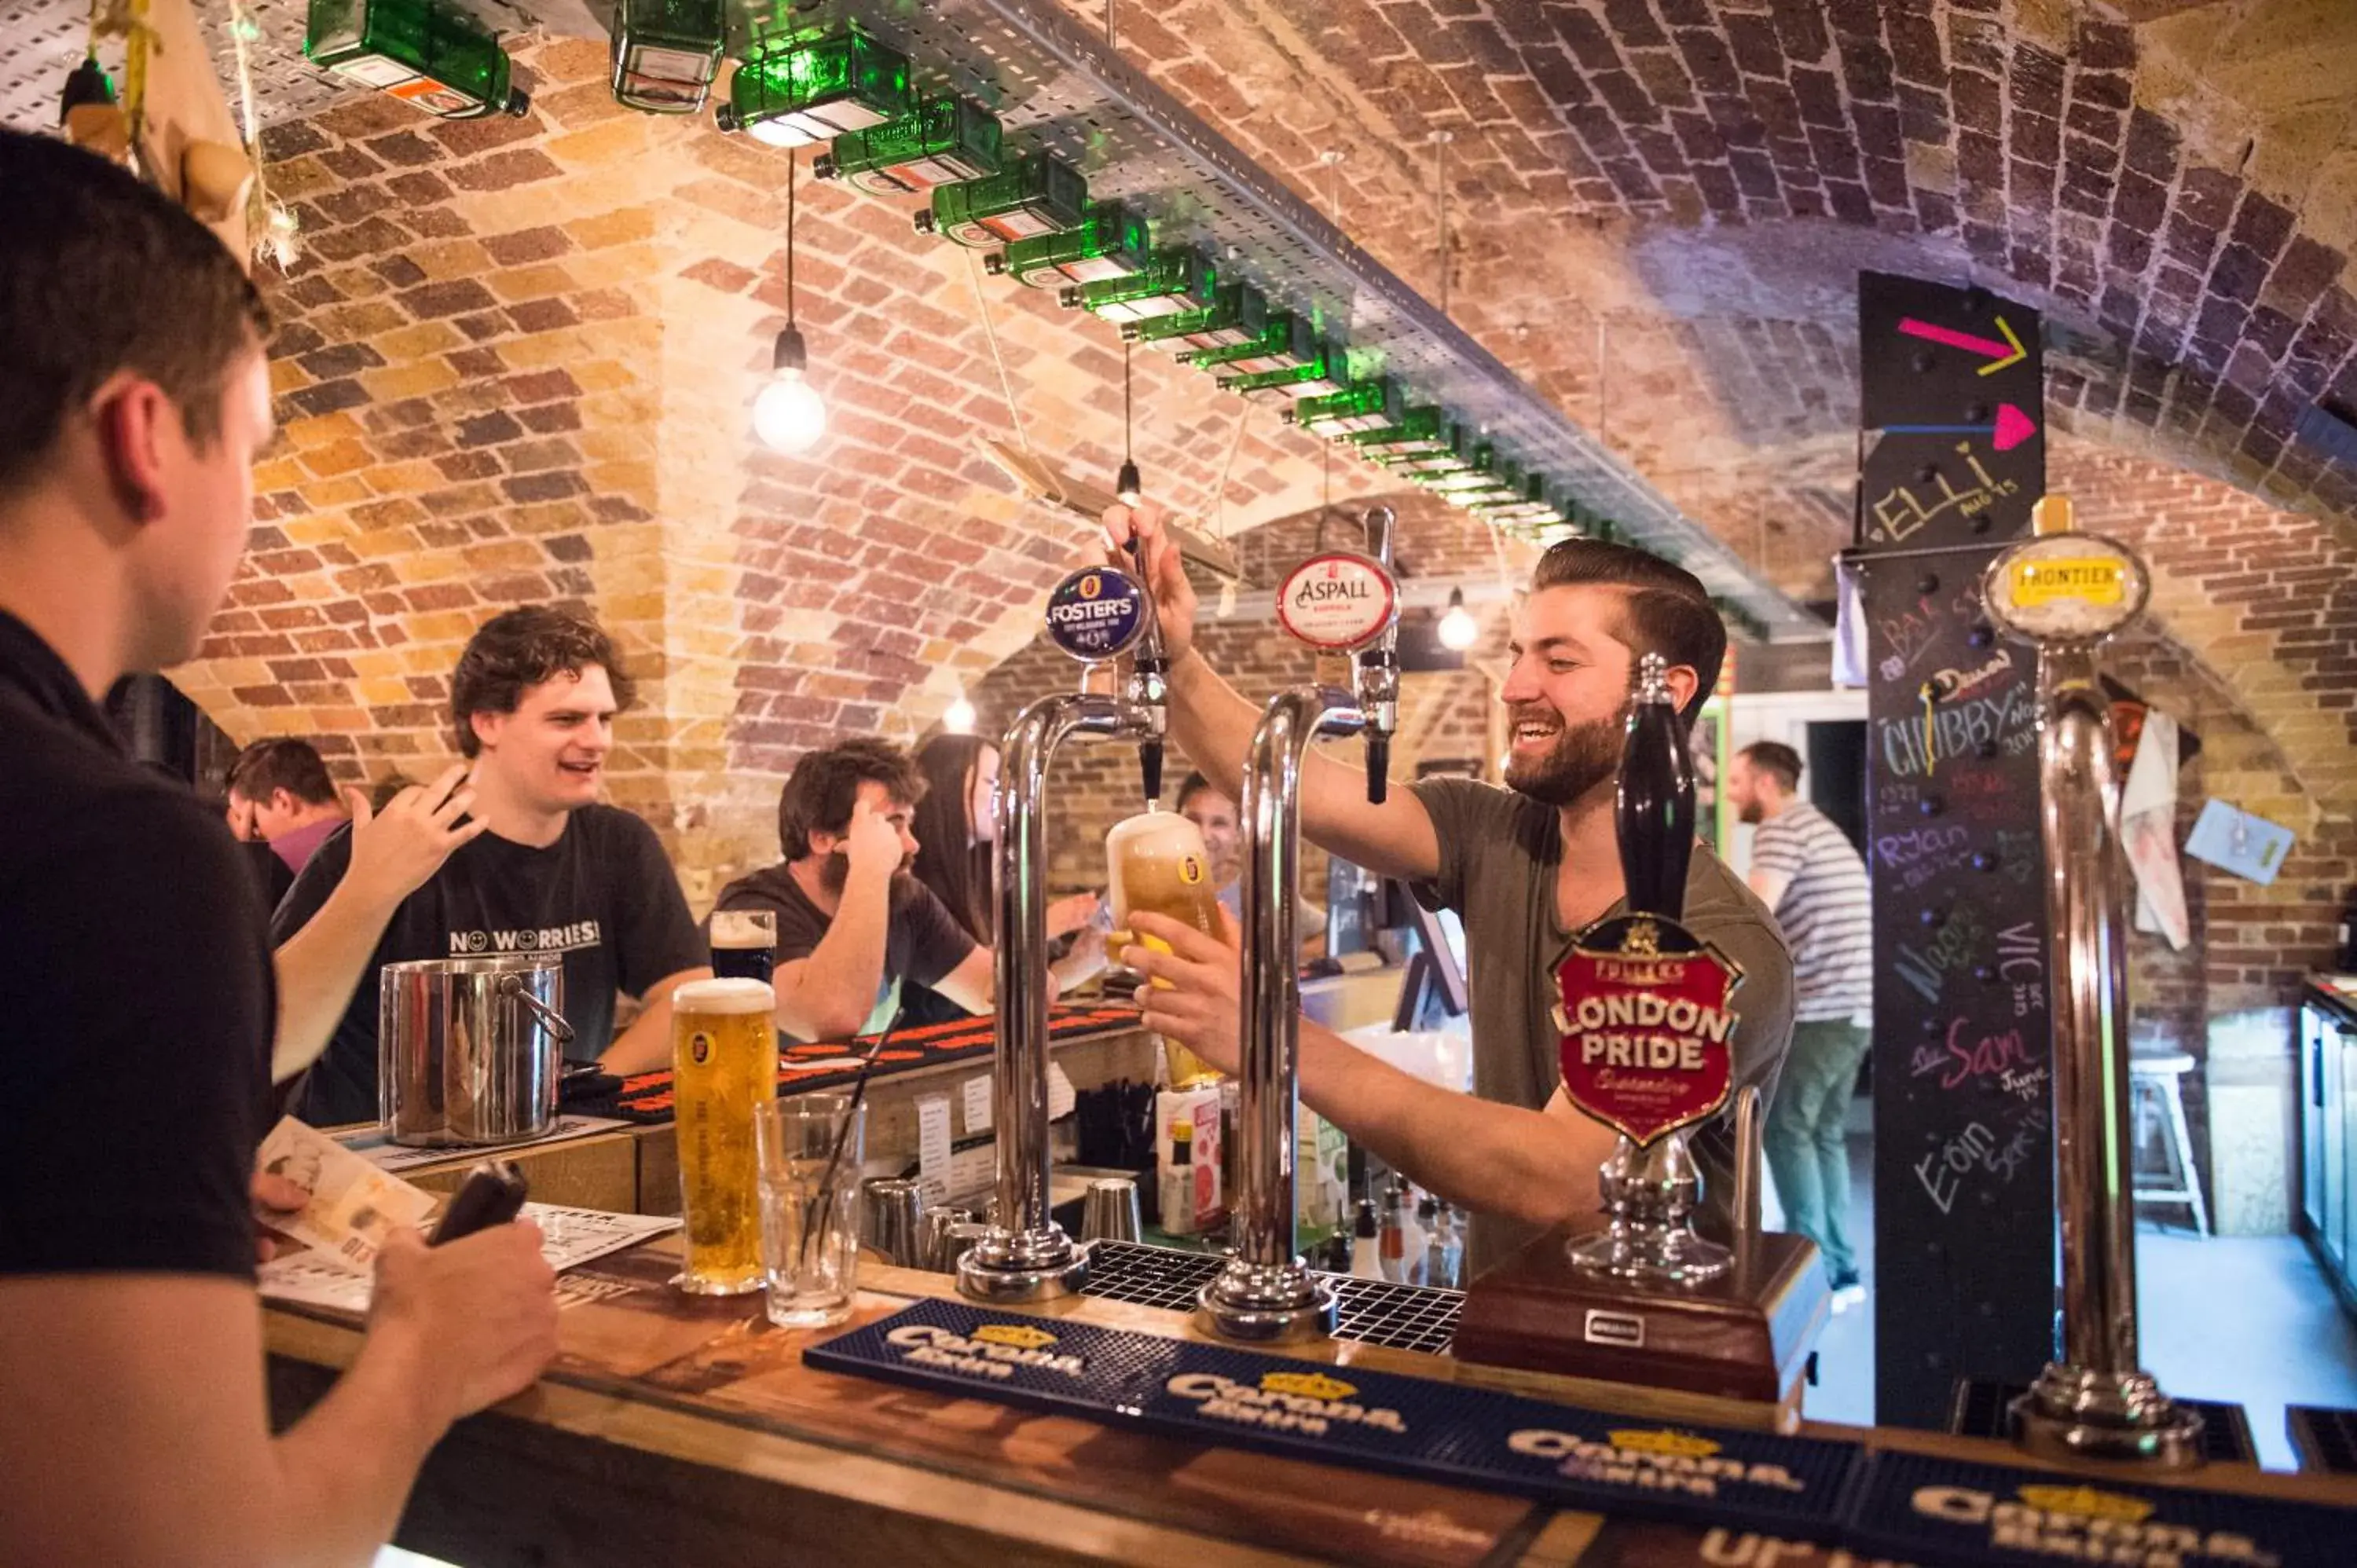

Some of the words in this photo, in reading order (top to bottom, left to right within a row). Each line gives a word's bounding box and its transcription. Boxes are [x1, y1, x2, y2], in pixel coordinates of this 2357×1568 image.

[1872, 456, 1994, 541] ELLI
[1052, 599, 1132, 622] FOSTER'S
[1296, 580, 1370, 609] ASPALL
[450, 930, 487, 951] NO
[493, 920, 601, 951] WORRIES!
[1996, 921, 2043, 981] VIC
[1551, 991, 1732, 1043] LONDON
[1581, 1033, 1705, 1070] PRIDE
[1940, 1017, 2036, 1090] Sam
[886, 1324, 1084, 1376] Corona
[1167, 1372, 1406, 1432] Corona
[1508, 1428, 1805, 1491] Corona
